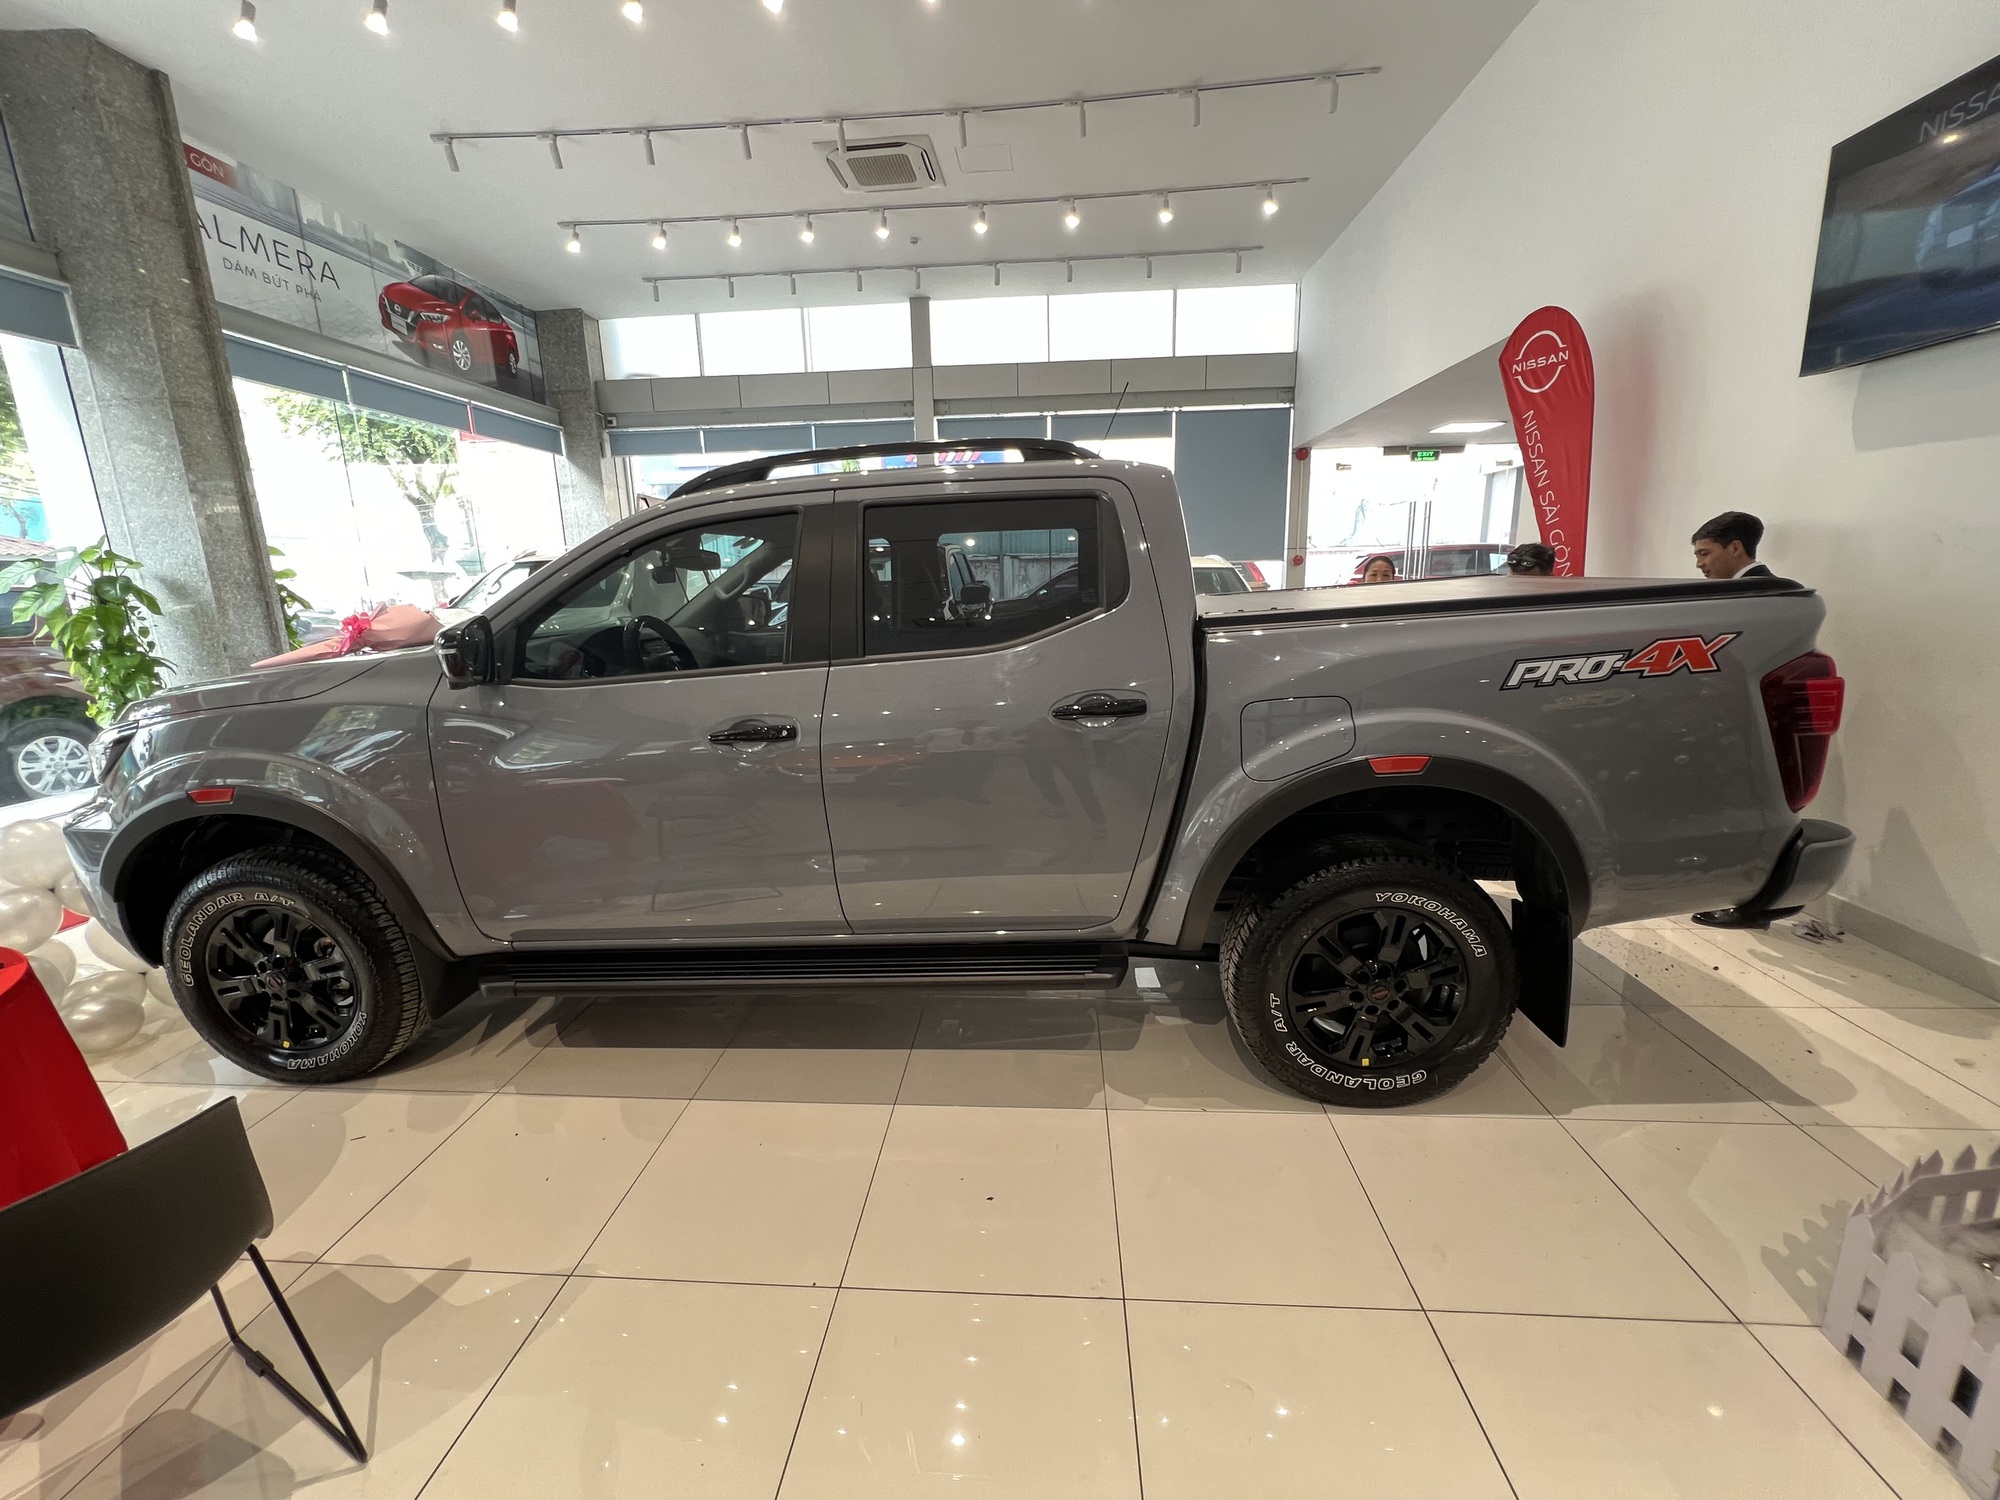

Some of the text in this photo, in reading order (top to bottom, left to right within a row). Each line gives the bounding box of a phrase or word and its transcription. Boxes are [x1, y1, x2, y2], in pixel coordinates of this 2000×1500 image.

[190, 152, 225, 178] GÒN
[1512, 350, 1569, 374] NISSAN
[1522, 410, 1574, 578] NISSAN SÀI GÒN
[1499, 631, 1743, 691] PRO-4X
[179, 892, 295, 987] GEOLANDAR A/T
[1375, 892, 1488, 958] YOKOHAMA
[287, 1011, 368, 1069] YOKOHAMA
[1269, 993, 1428, 1091] GEOLANDAR A/T
